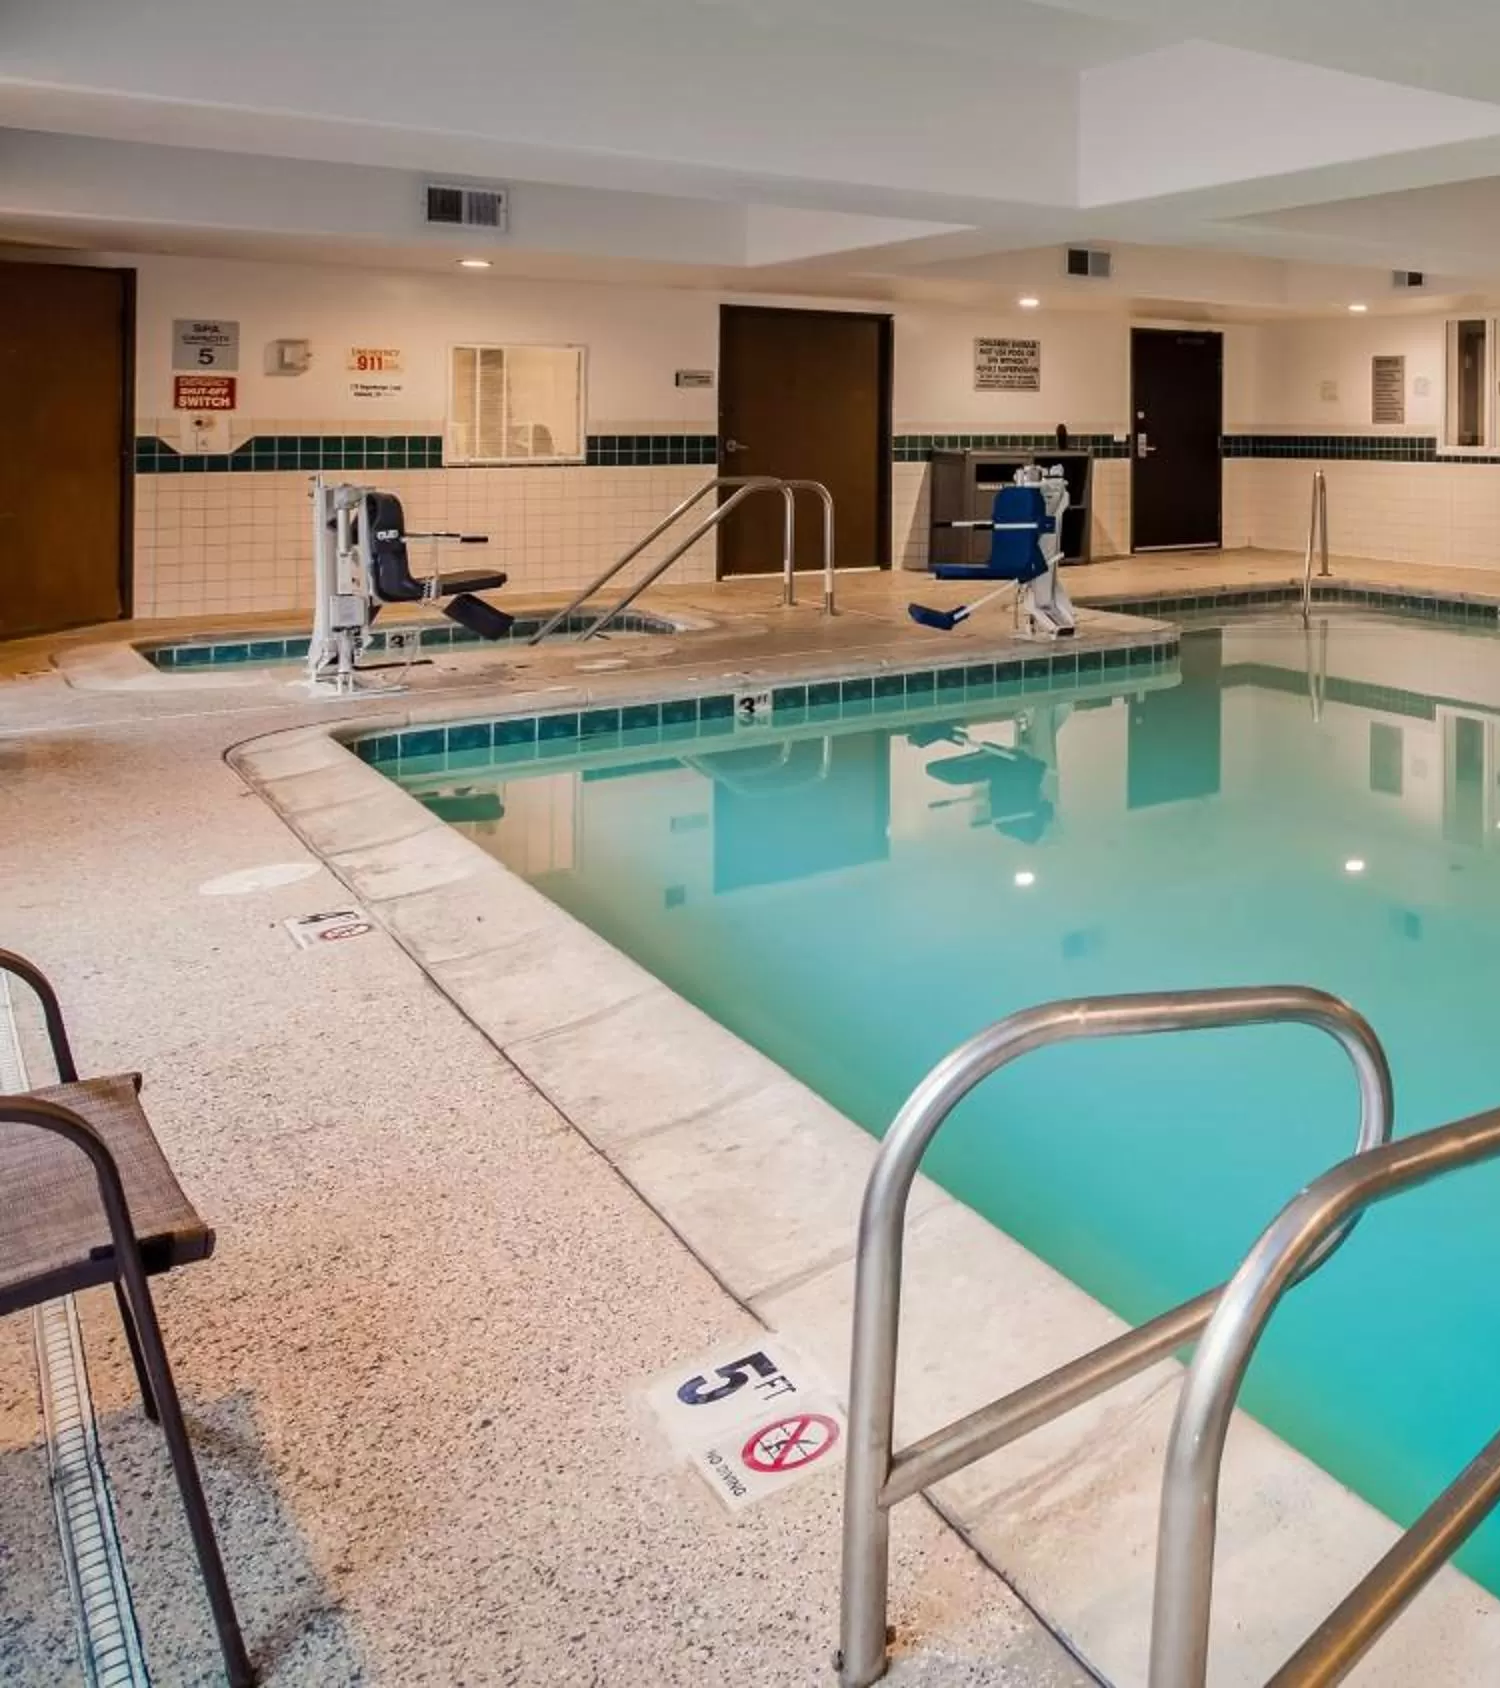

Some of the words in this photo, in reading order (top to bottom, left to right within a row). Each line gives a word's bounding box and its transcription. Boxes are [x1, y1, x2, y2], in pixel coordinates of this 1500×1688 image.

[192, 323, 220, 333] SPA
[198, 348, 214, 365] 5
[357, 355, 382, 371] 911
[178, 396, 231, 407] SWITCH
[390, 634, 405, 648] 3
[740, 697, 755, 713] 3
[677, 1351, 779, 1405] 5
[753, 1375, 797, 1401] FT
[705, 1449, 723, 1465] NO
